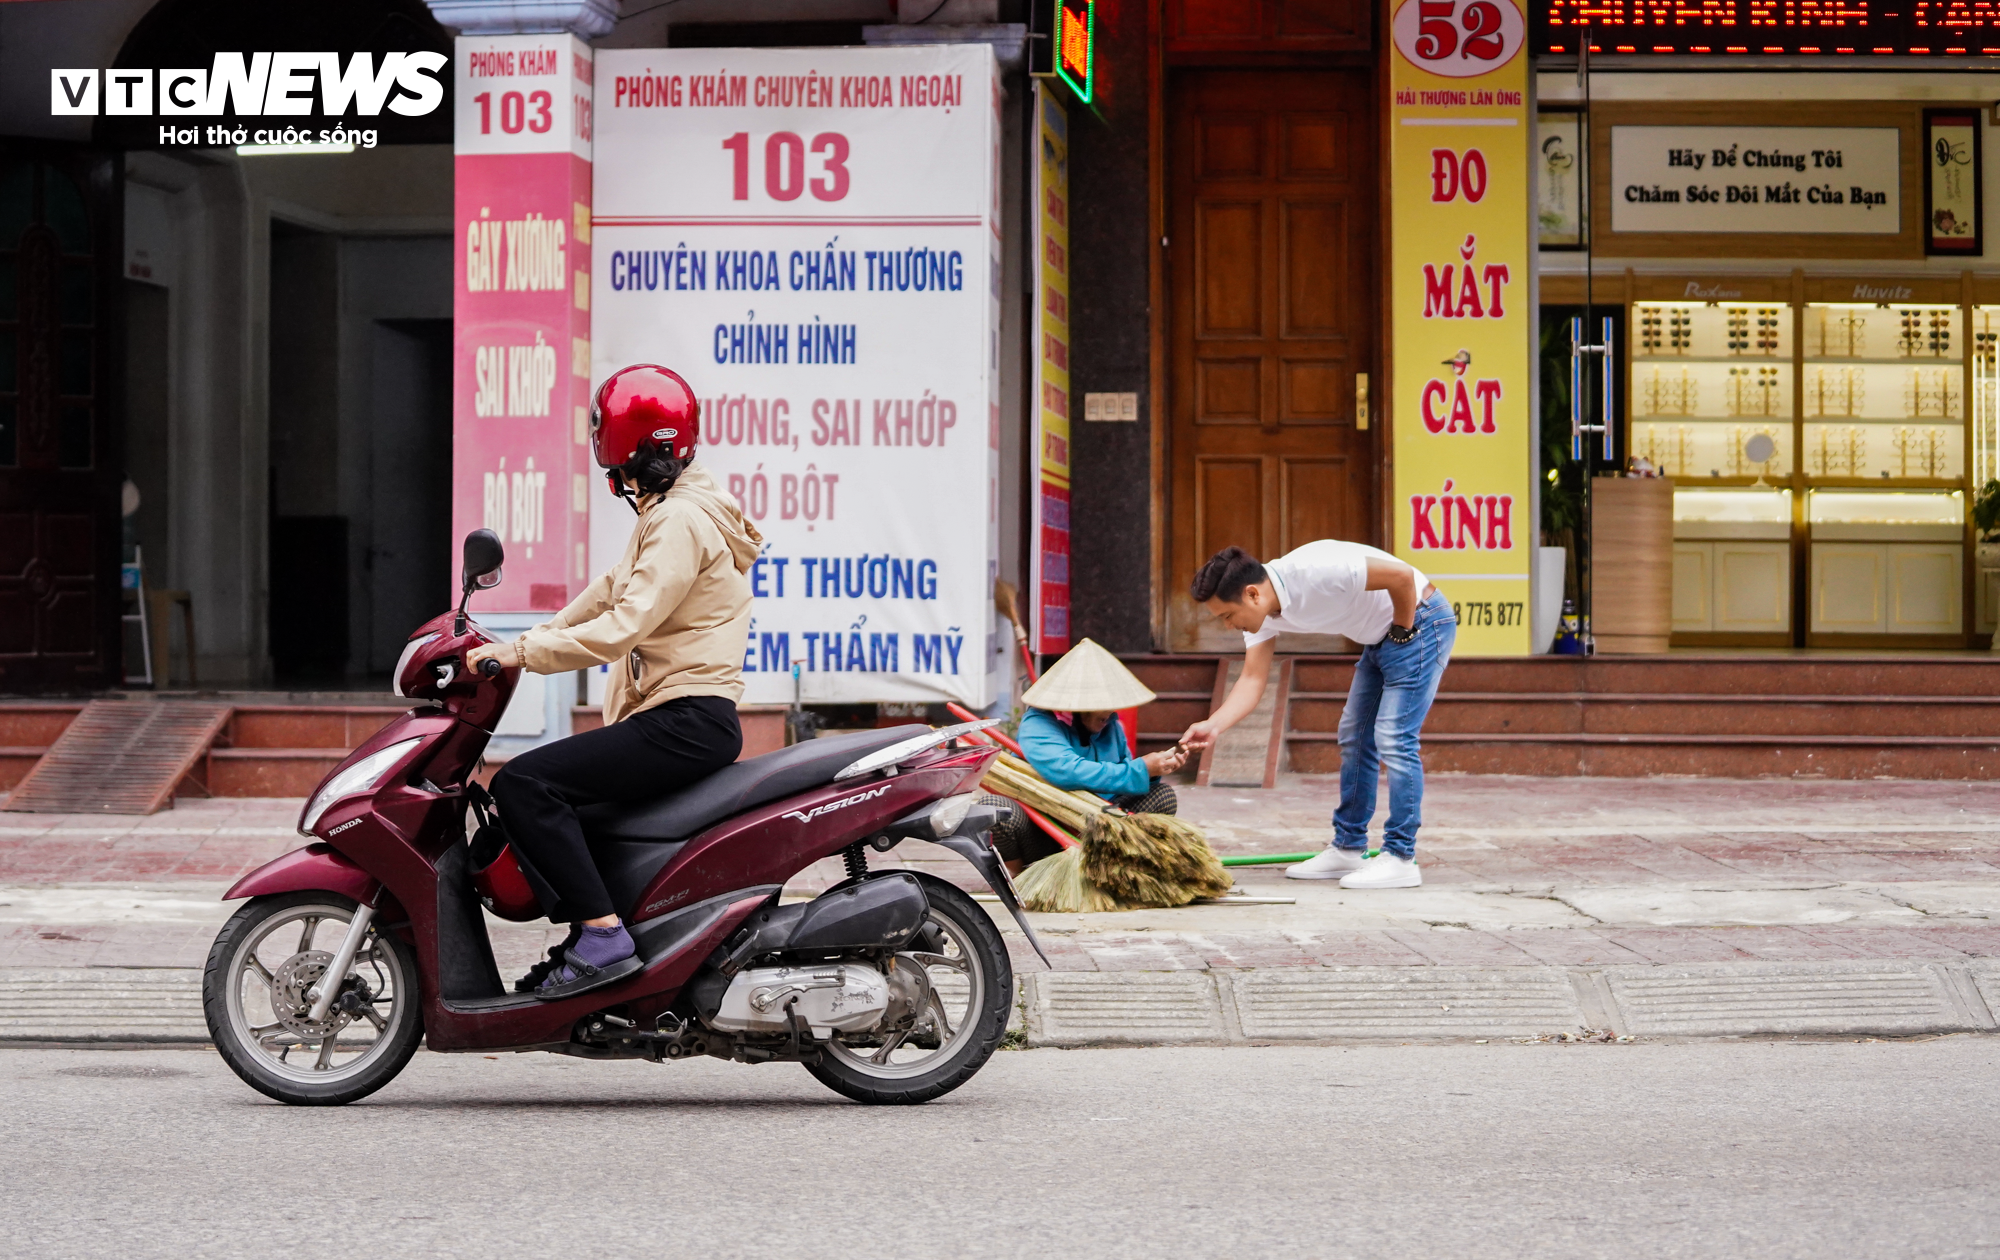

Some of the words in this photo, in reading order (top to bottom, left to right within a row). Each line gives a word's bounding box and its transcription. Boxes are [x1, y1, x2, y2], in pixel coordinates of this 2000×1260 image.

[1414, 0, 1504, 60] 52
[469, 44, 515, 78] PHÒNG
[518, 43, 557, 77] KHÁM
[473, 89, 553, 135] 103
[614, 68, 683, 108] PHÒNG
[688, 68, 748, 108] KHÁM
[753, 69, 834, 108] CHUYÊN
[839, 74, 893, 108] KHOA
[900, 74, 962, 114] NGOẠI
[1395, 86, 1416, 106] HẢI
[1419, 88, 1467, 108] THƯỢNG
[1496, 87, 1522, 106] ÔNG
[721, 130, 851, 202] 103
[1430, 148, 1488, 203] ĐO
[1667, 148, 1706, 170] Hãy
[1711, 143, 1738, 168] Để
[1742, 148, 1807, 172] Chúng
[1811, 149, 1843, 168] Tôi
[1623, 184, 1680, 203] Chăm
[1685, 184, 1720, 203] Sóc
[1725, 184, 1759, 203] Đôi
[1764, 181, 1801, 203] Mắt
[1806, 183, 1844, 204] Của
[1849, 185, 1887, 210] Bạn
[466, 205, 502, 292] GÃY
[503, 211, 567, 292] XƯƠNG
[609, 241, 707, 292] CHUYÊN
[715, 249, 781, 292] KHOA
[788, 235, 857, 292] CHẤN
[863, 246, 964, 292] THƯƠNG
[1422, 233, 1510, 319] MẮT
[1852, 284, 1913, 299] Huvitz
[713, 309, 790, 365] CHỈNH
[796, 314, 857, 365] HÌNH
[474, 344, 505, 418] SAI
[507, 329, 557, 418] KHỚP
[810, 398, 861, 447] SAI
[872, 388, 958, 448] KHỚP
[483, 455, 509, 543] BÓ
[510, 455, 547, 560] BỘT
[728, 462, 769, 522] BÓ
[779, 462, 840, 532] BỘT
[1409, 478, 1513, 550] KÍNH
[752, 542, 790, 598] ẾT
[799, 552, 938, 601] THƯƠNG
[1465, 601, 1493, 626] 775
[1497, 601, 1524, 626] 877
[742, 617, 790, 673] ỀM
[801, 613, 899, 674] THẨM
[912, 626, 965, 676] MỸ
[328, 817, 364, 837] HONDA
[781, 784, 892, 824] VISION
